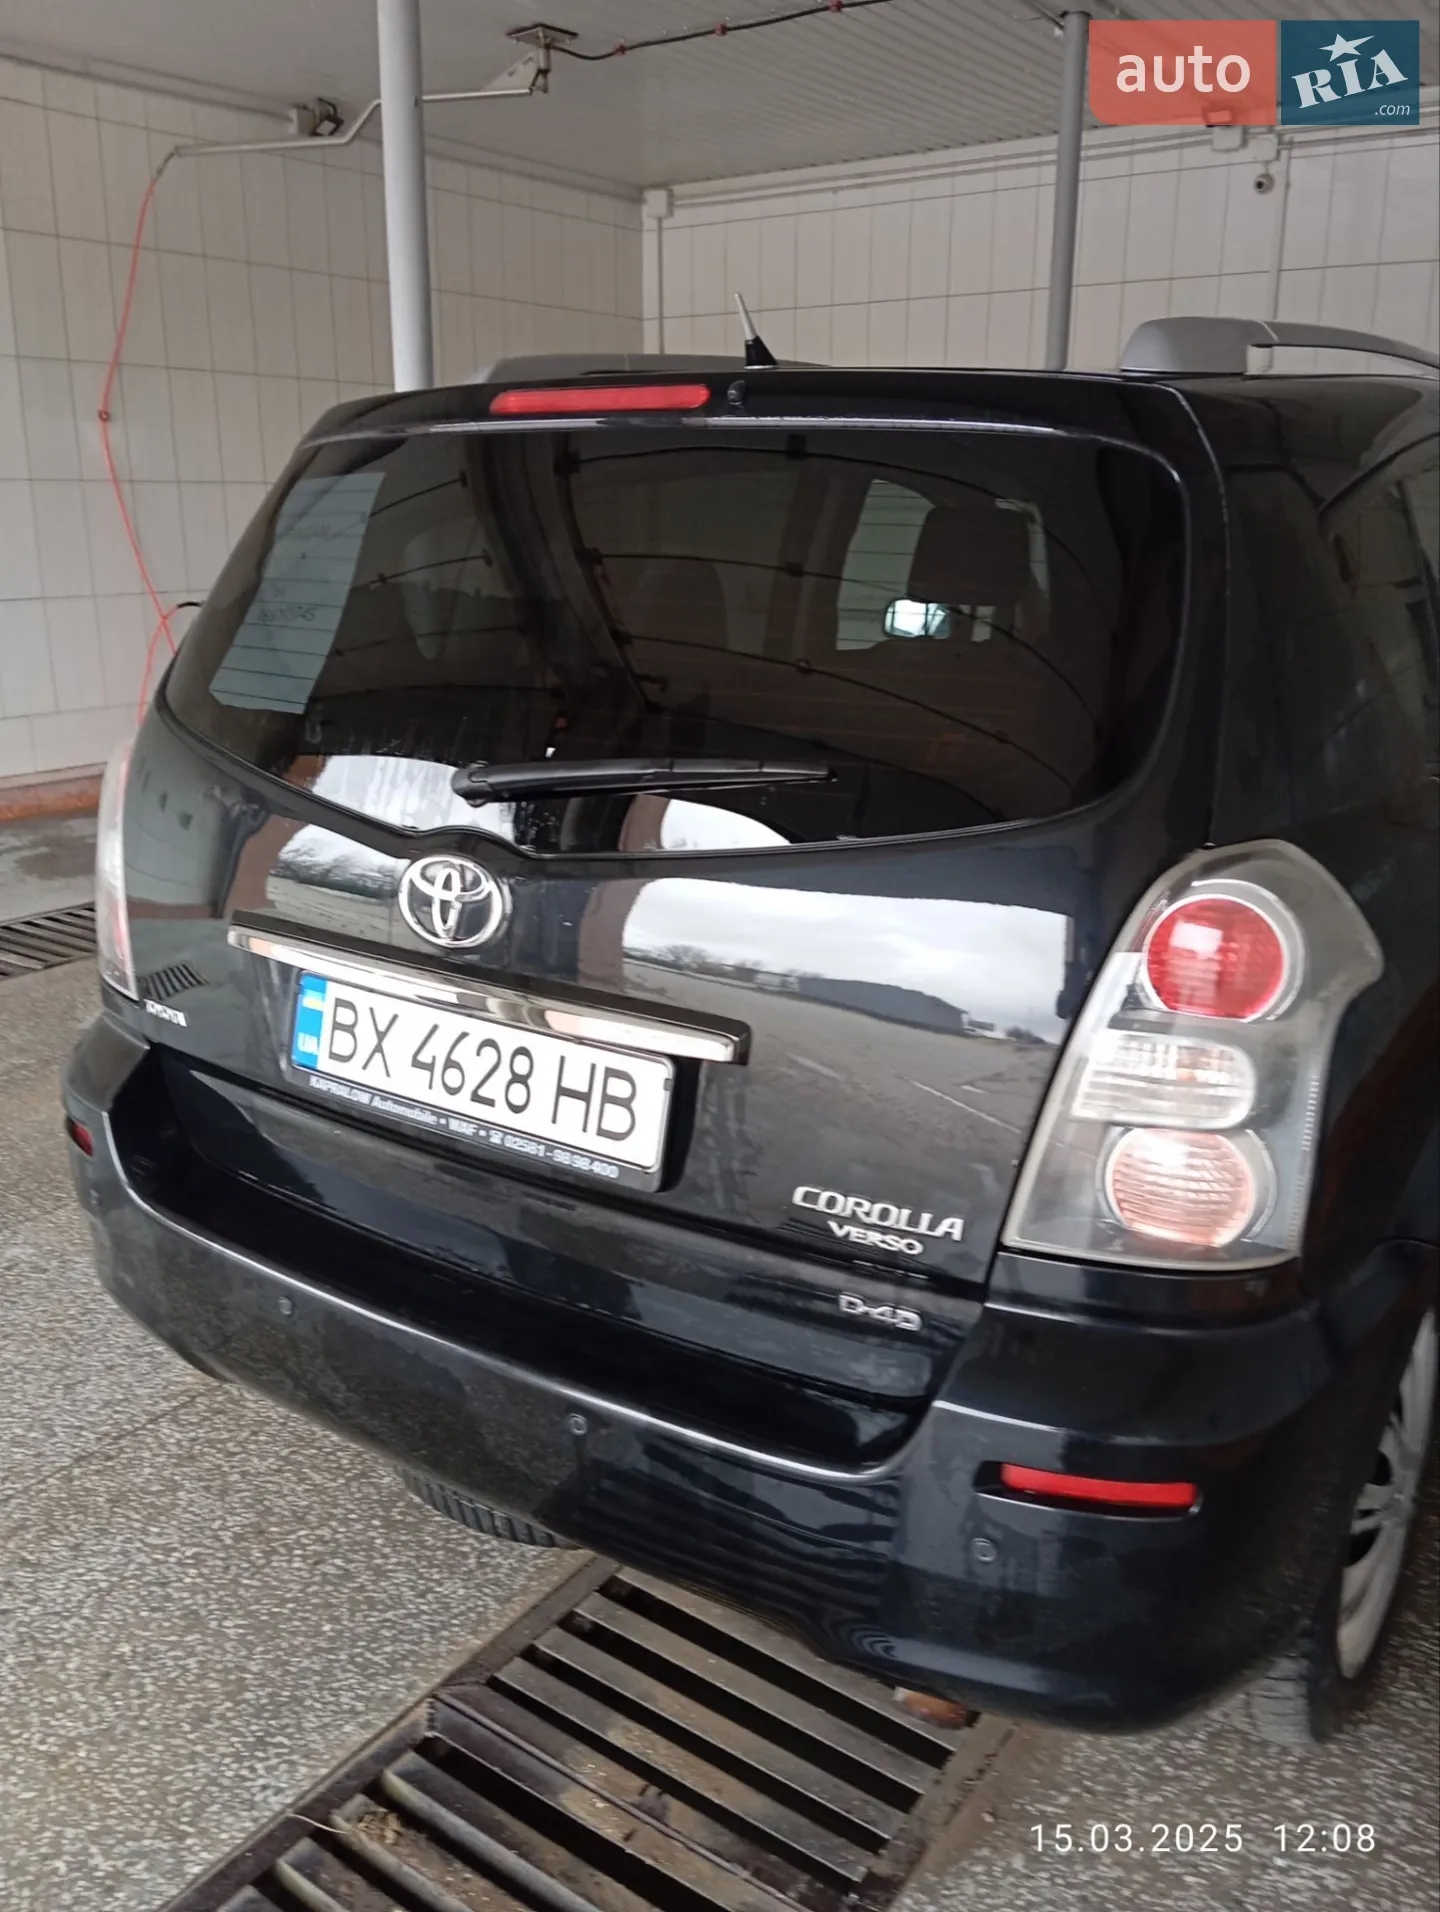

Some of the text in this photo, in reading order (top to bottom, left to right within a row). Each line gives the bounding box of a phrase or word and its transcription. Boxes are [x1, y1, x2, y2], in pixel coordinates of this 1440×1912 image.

[328, 997, 637, 1142] BX 4628 HB
[792, 1186, 965, 1241] COROLLA
[827, 1220, 923, 1255] VERSO
[839, 1294, 923, 1331] D-4D
